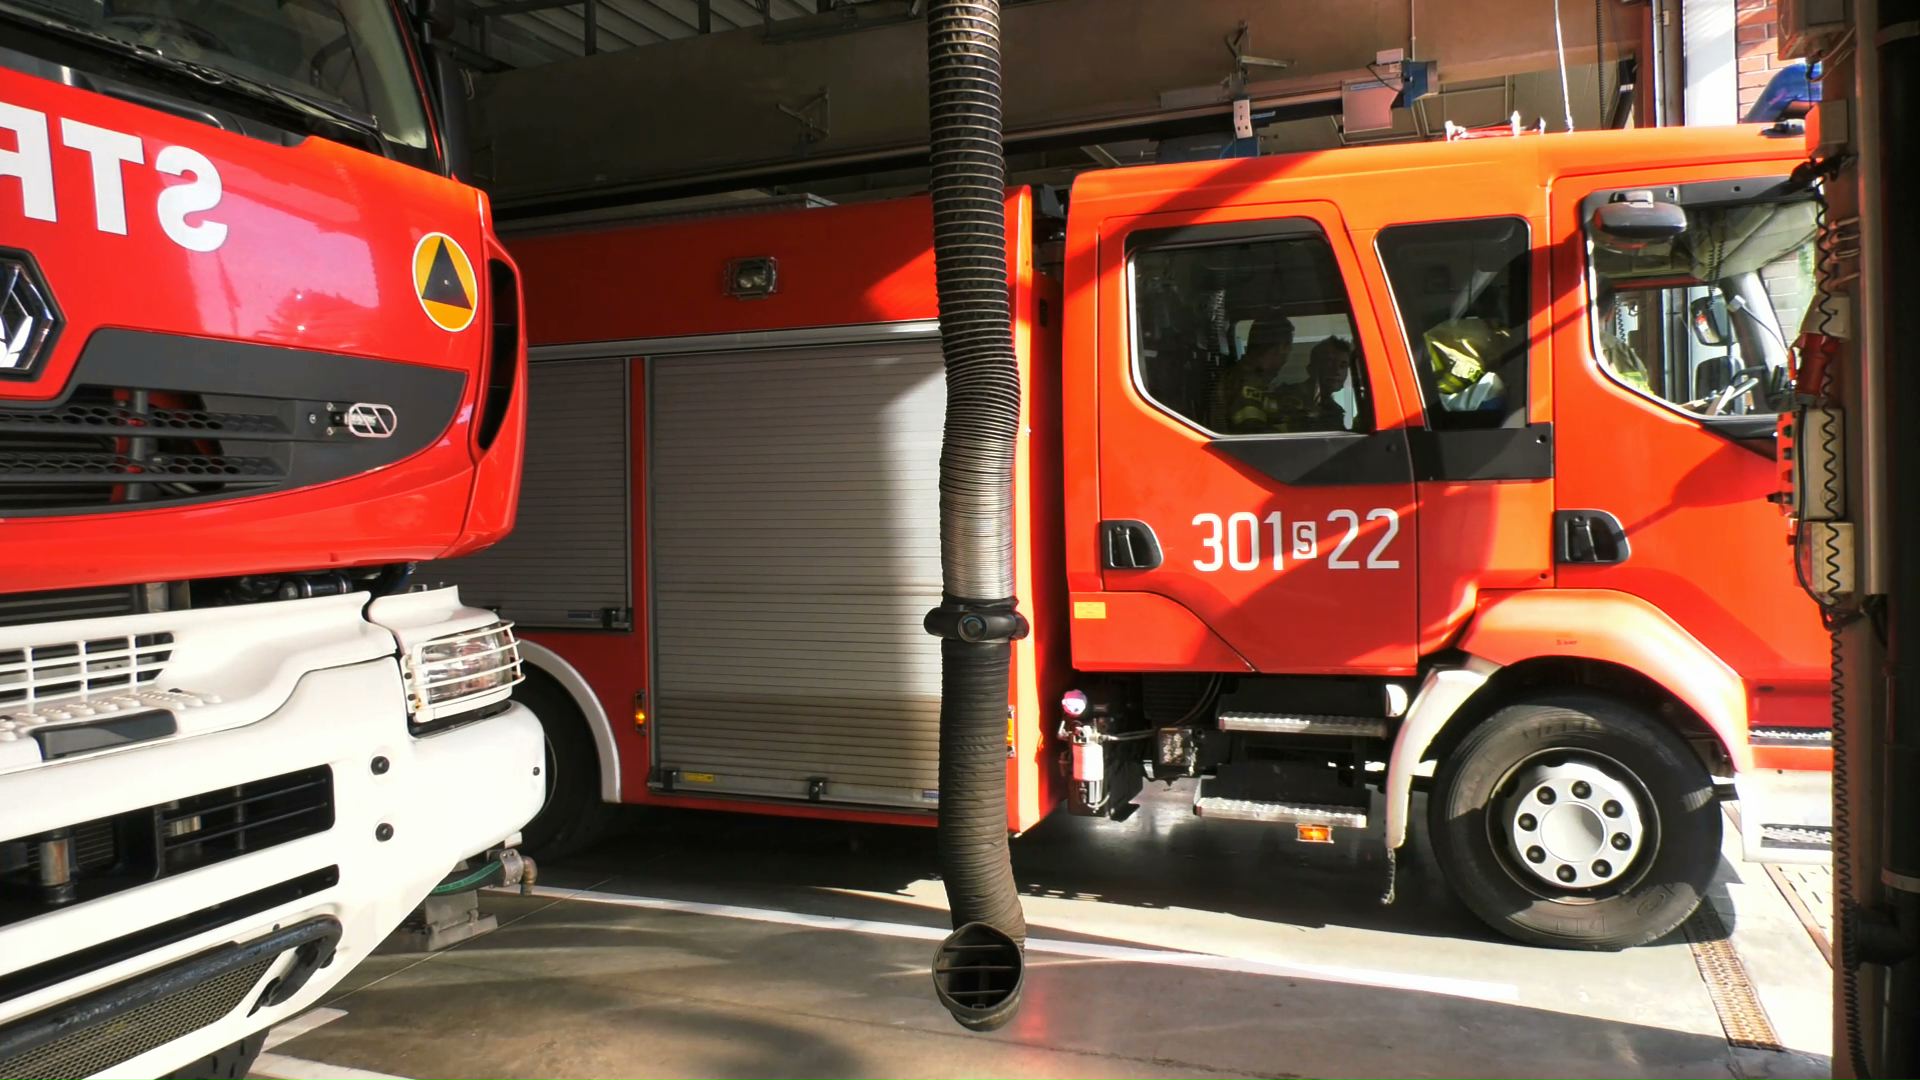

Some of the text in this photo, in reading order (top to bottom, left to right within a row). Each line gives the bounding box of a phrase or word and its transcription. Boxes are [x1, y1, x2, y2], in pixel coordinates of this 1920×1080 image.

[1192, 508, 1400, 572] 301 S 22
